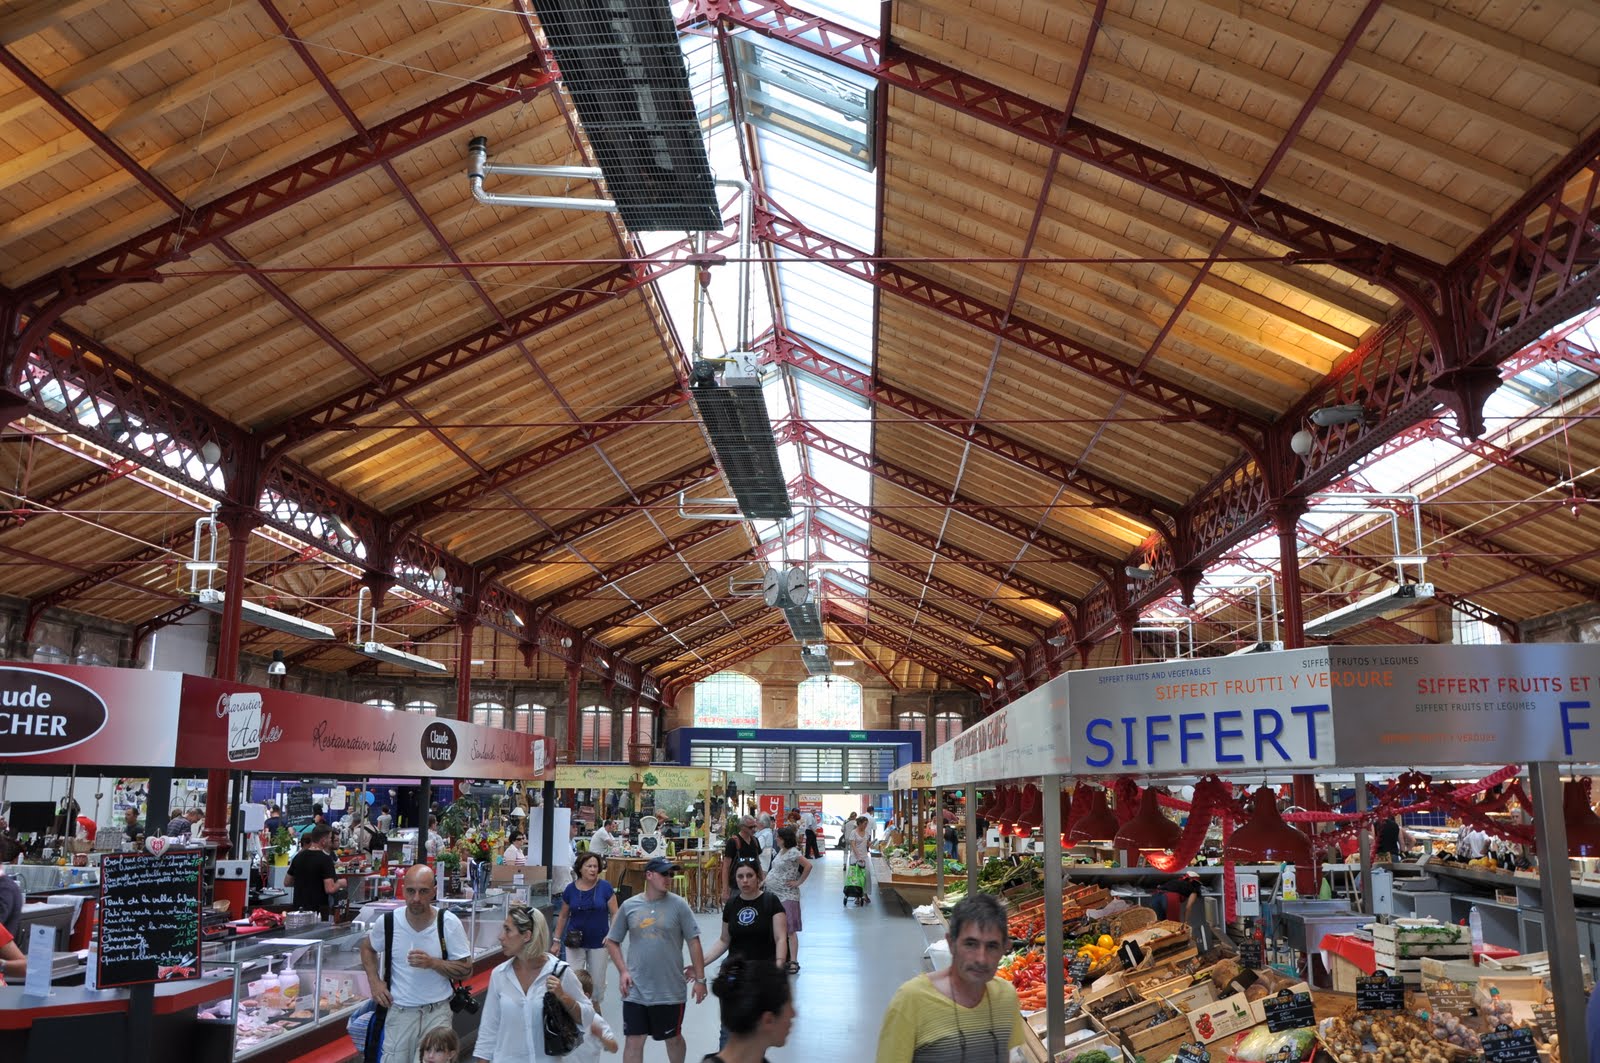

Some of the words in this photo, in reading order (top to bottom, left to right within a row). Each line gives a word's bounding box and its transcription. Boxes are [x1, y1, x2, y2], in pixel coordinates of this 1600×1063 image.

[1302, 657, 1334, 668] SIFFERT
[1337, 657, 1369, 666] FRUTOS
[1372, 657, 1378, 665] Y
[1380, 656, 1419, 665] LEGUMES
[1099, 675, 1124, 684] SIFFERT
[1126, 673, 1150, 682] FRUITS
[1152, 671, 1166, 680] AND
[1167, 667, 1212, 678] VEGETABLES
[1156, 682, 1218, 700] SIFFERT
[1225, 676, 1283, 695] FRUTTI
[1290, 675, 1300, 689] Y
[1306, 671, 1393, 688] VERDURE
[1417, 678, 1490, 694] SIFFERT
[1497, 677, 1563, 693] FRUITS
[1570, 676, 1591, 692] ET
[1415, 703, 1448, 712] SIFFERT
[1451, 702, 1482, 711] FRUITS
[1484, 702, 1495, 711] ET
[1497, 702, 1537, 710] LEGUMES
[231, 711, 283, 748] Halles
[430, 730, 449, 744] Claude
[1085, 704, 1330, 767] SIFFERT
[312, 720, 370, 751] Restauration
[373, 732, 398, 760] rapide
[426, 746, 452, 760] WUCHER
